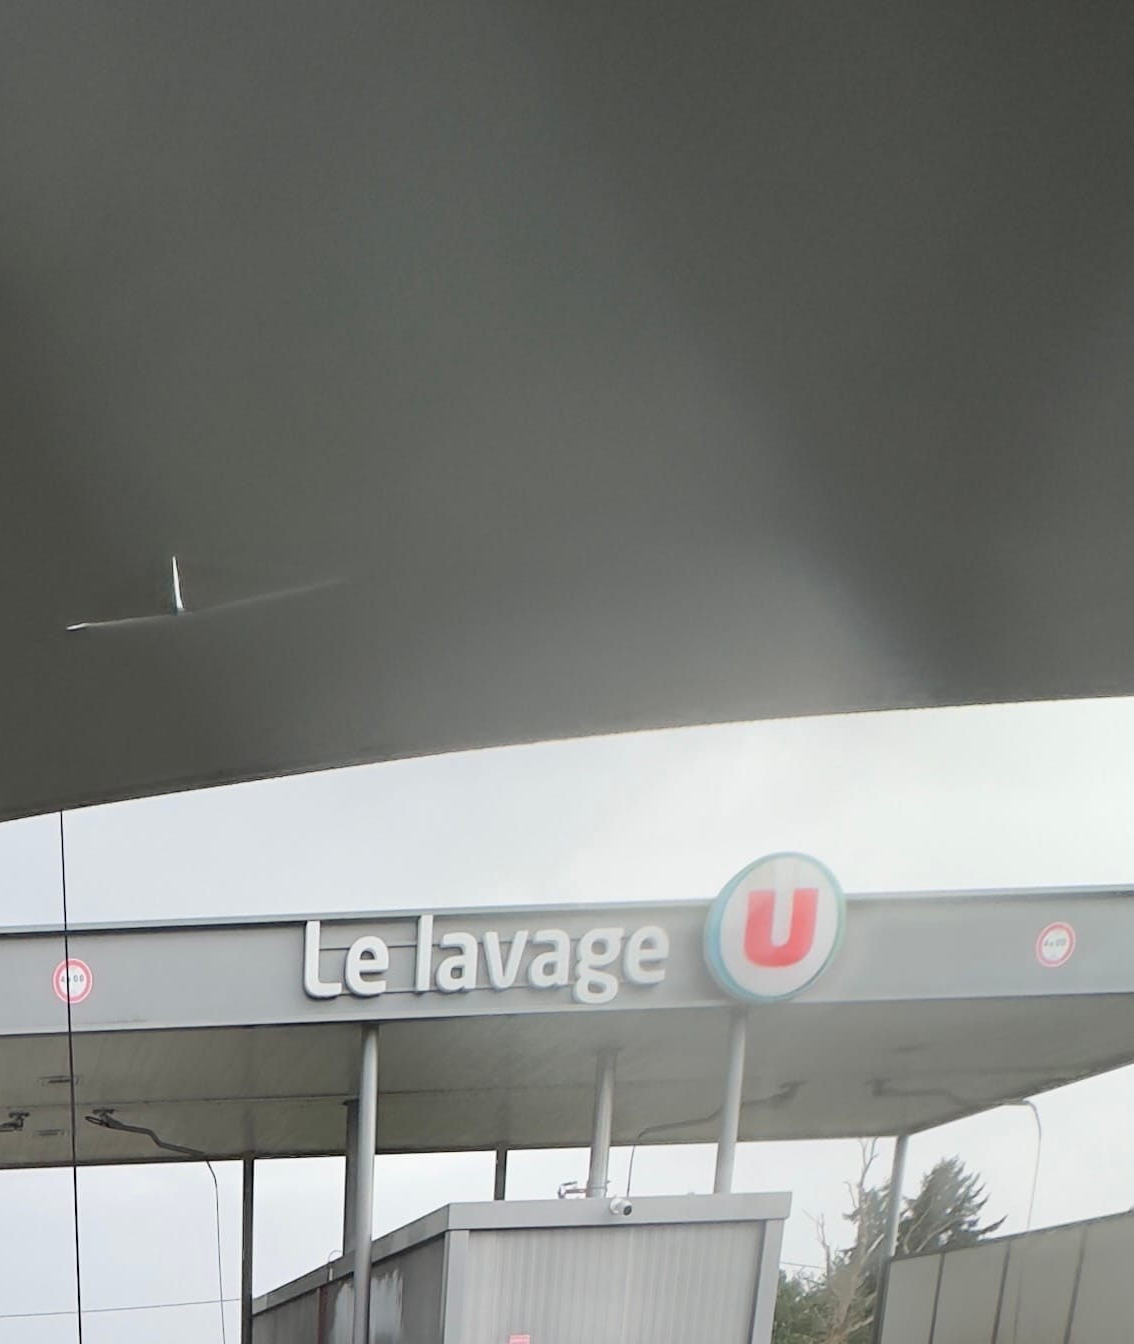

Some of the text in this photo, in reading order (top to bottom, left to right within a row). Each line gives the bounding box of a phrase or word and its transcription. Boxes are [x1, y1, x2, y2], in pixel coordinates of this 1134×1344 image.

[304, 914, 670, 1004] Le lavage
[743, 887, 819, 968] U
